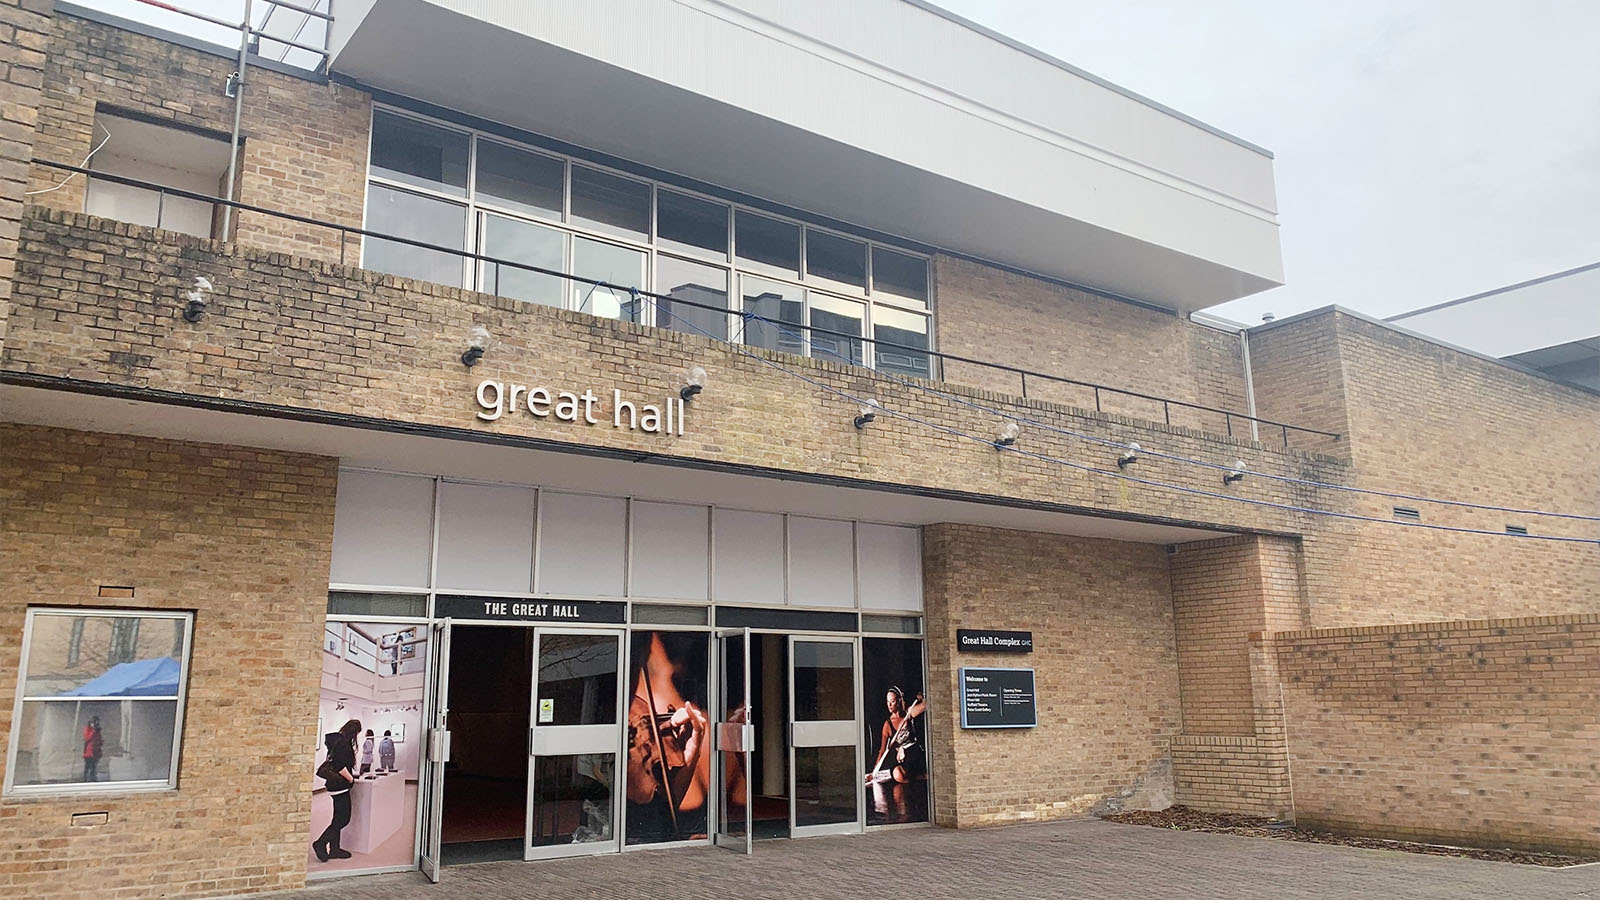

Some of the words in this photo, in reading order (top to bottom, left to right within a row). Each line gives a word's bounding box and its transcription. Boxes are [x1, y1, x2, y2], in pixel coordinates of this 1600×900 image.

[476, 379, 598, 424] great
[613, 388, 684, 436] hall
[484, 602, 507, 615] THE
[512, 603, 548, 616] GREAT
[553, 605, 580, 618] HALL
[962, 636, 980, 645] Great
[980, 636, 993, 645] Hall
[994, 637, 1021, 647] Complex
